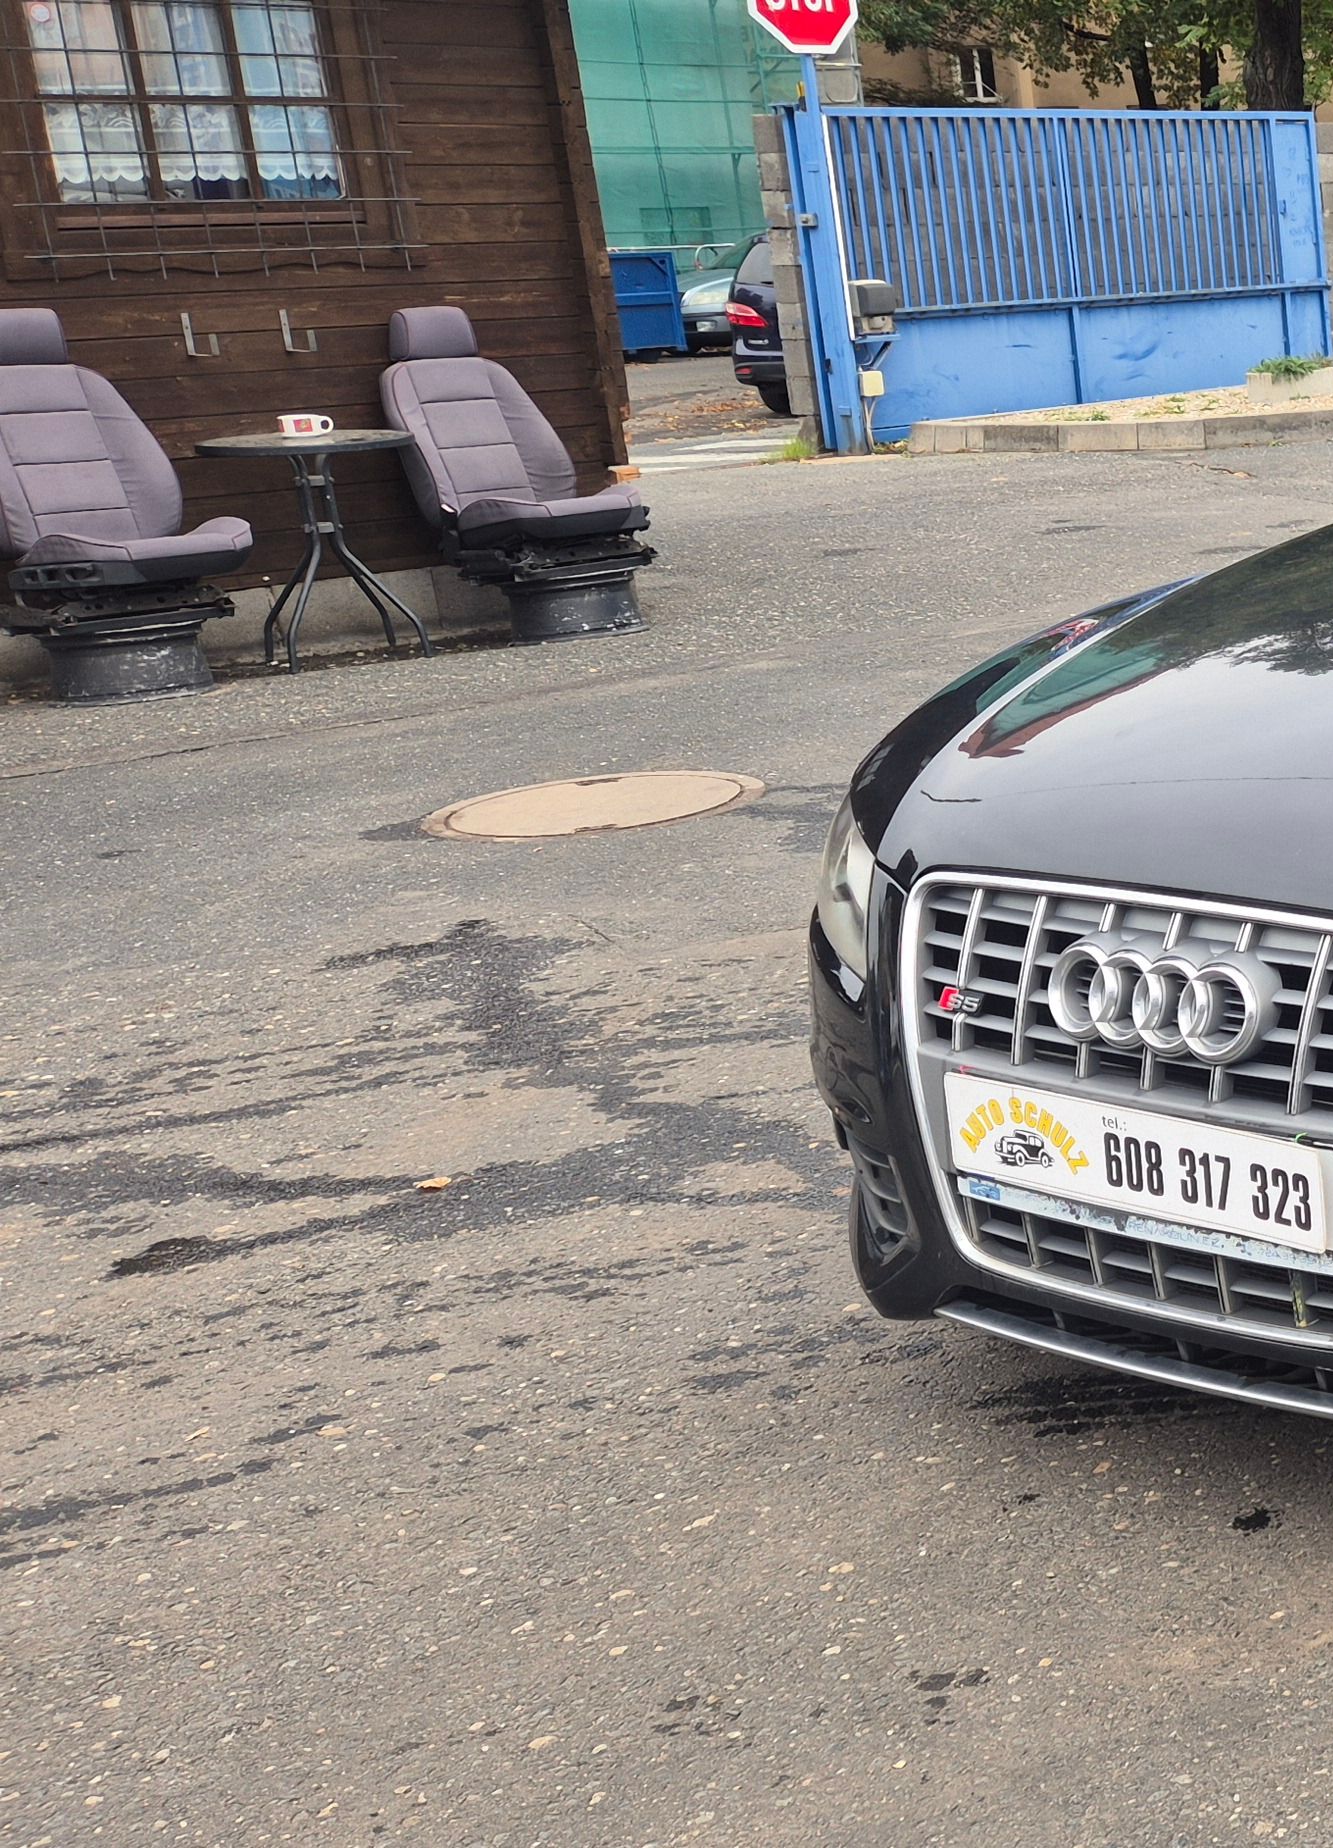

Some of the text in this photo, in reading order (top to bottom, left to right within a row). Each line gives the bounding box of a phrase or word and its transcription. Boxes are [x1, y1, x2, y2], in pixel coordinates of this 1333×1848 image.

[947, 992, 980, 1012] S5
[959, 1096, 1090, 1175] AUTO SCHULZ
[1102, 1115, 1127, 1132] tel.:
[1104, 1132, 1165, 1197] 608
[1178, 1147, 1231, 1211] 317
[1250, 1163, 1312, 1232] 323
